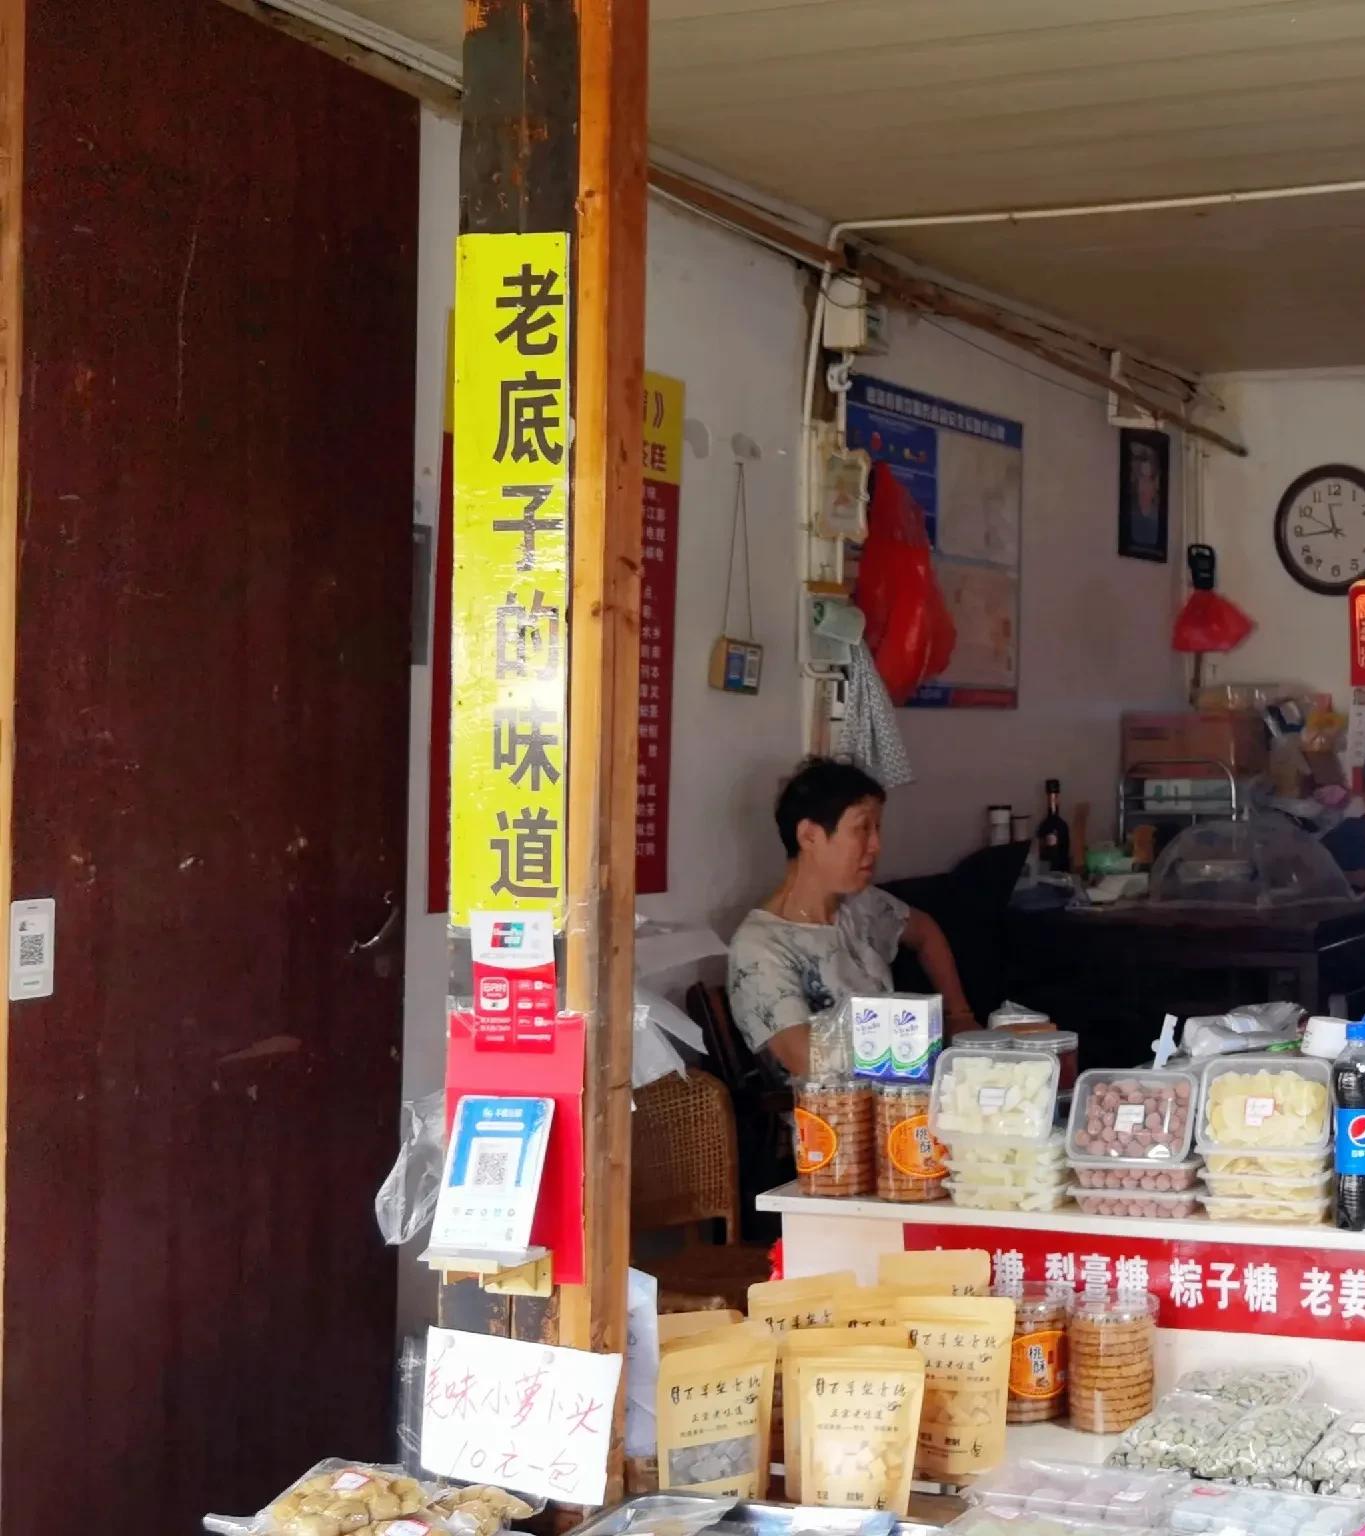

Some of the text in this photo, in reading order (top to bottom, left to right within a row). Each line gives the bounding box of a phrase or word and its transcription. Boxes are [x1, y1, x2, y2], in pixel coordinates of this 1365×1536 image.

[490, 263, 565, 899] 老底子的味道
[1169, 1257, 1279, 1314] 粽子糖
[450, 1440, 580, 1495] 10元一包
